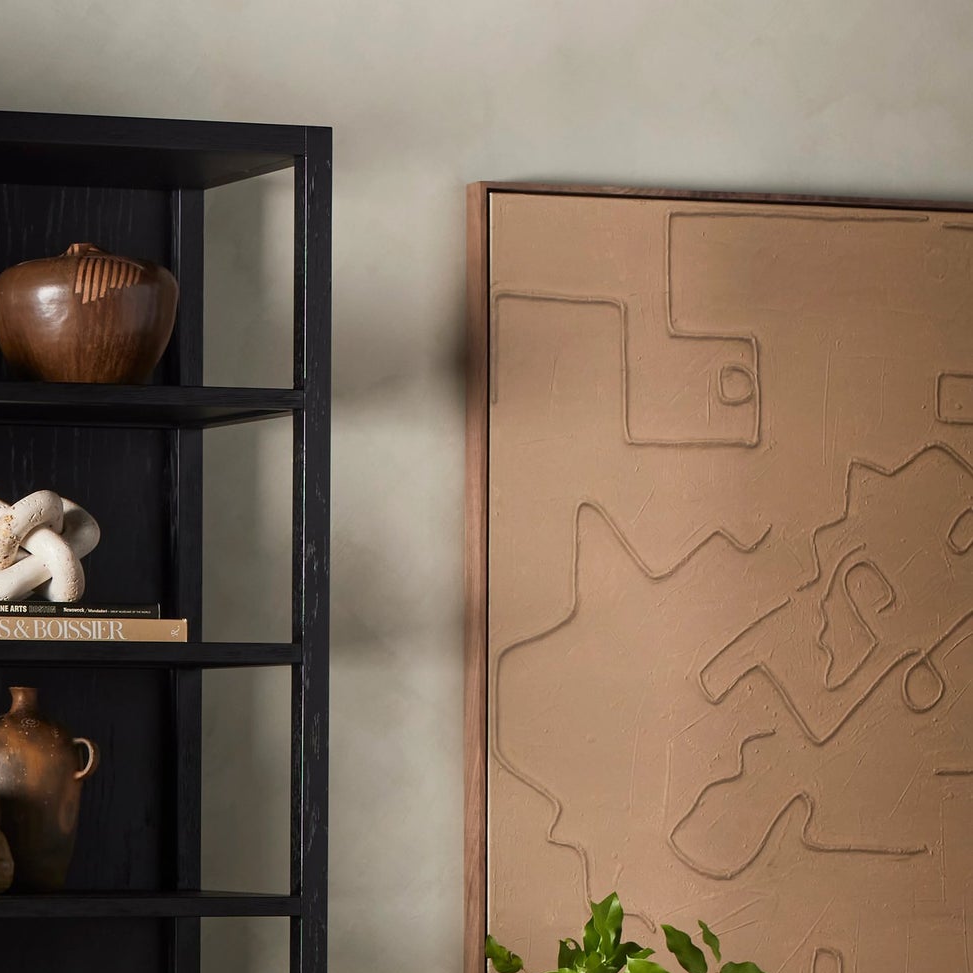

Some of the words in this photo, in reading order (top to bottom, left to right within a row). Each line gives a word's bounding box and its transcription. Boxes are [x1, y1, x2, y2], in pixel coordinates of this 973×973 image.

[10, 605, 27, 613] ARTS
[13, 619, 30, 639] &
[33, 619, 128, 641] BOISSIER
